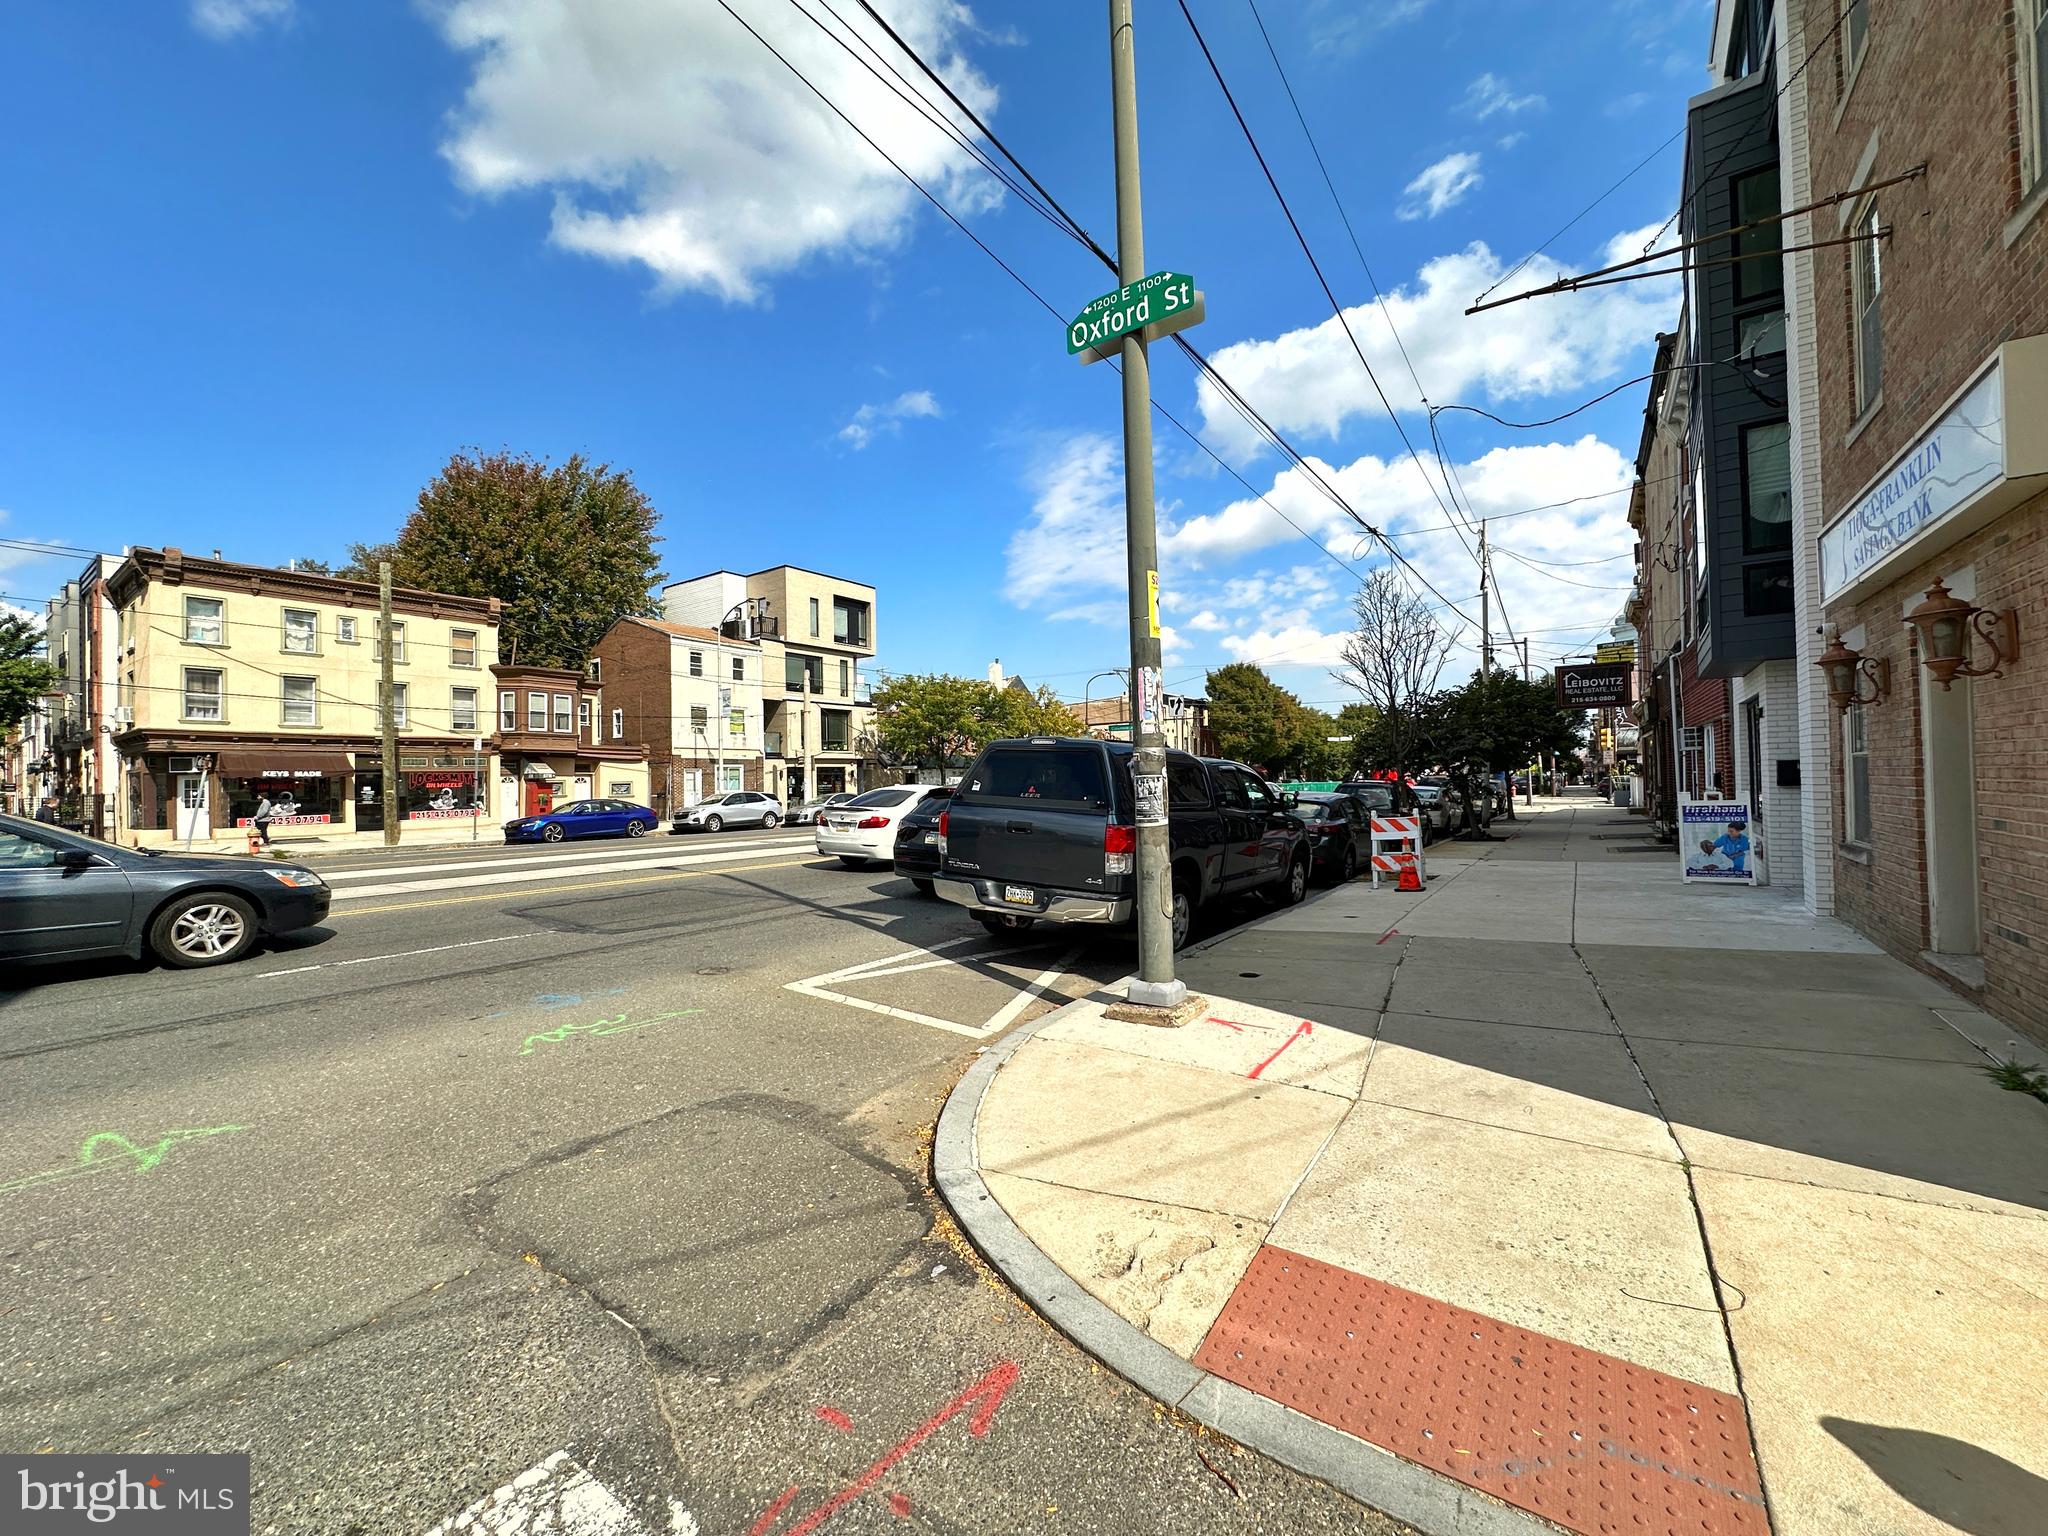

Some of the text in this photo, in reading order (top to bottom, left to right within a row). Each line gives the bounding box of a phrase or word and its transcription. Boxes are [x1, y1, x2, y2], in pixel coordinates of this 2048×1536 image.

[1071, 282, 1190, 348] Oxford St
[1092, 275, 1162, 312] 1200 E 1100
[1846, 435, 1943, 542] TIOGA-FRANKLIN
[1853, 487, 1934, 571] SAVINGS BANK
[1563, 675, 1624, 688] LEIBOVITZ
